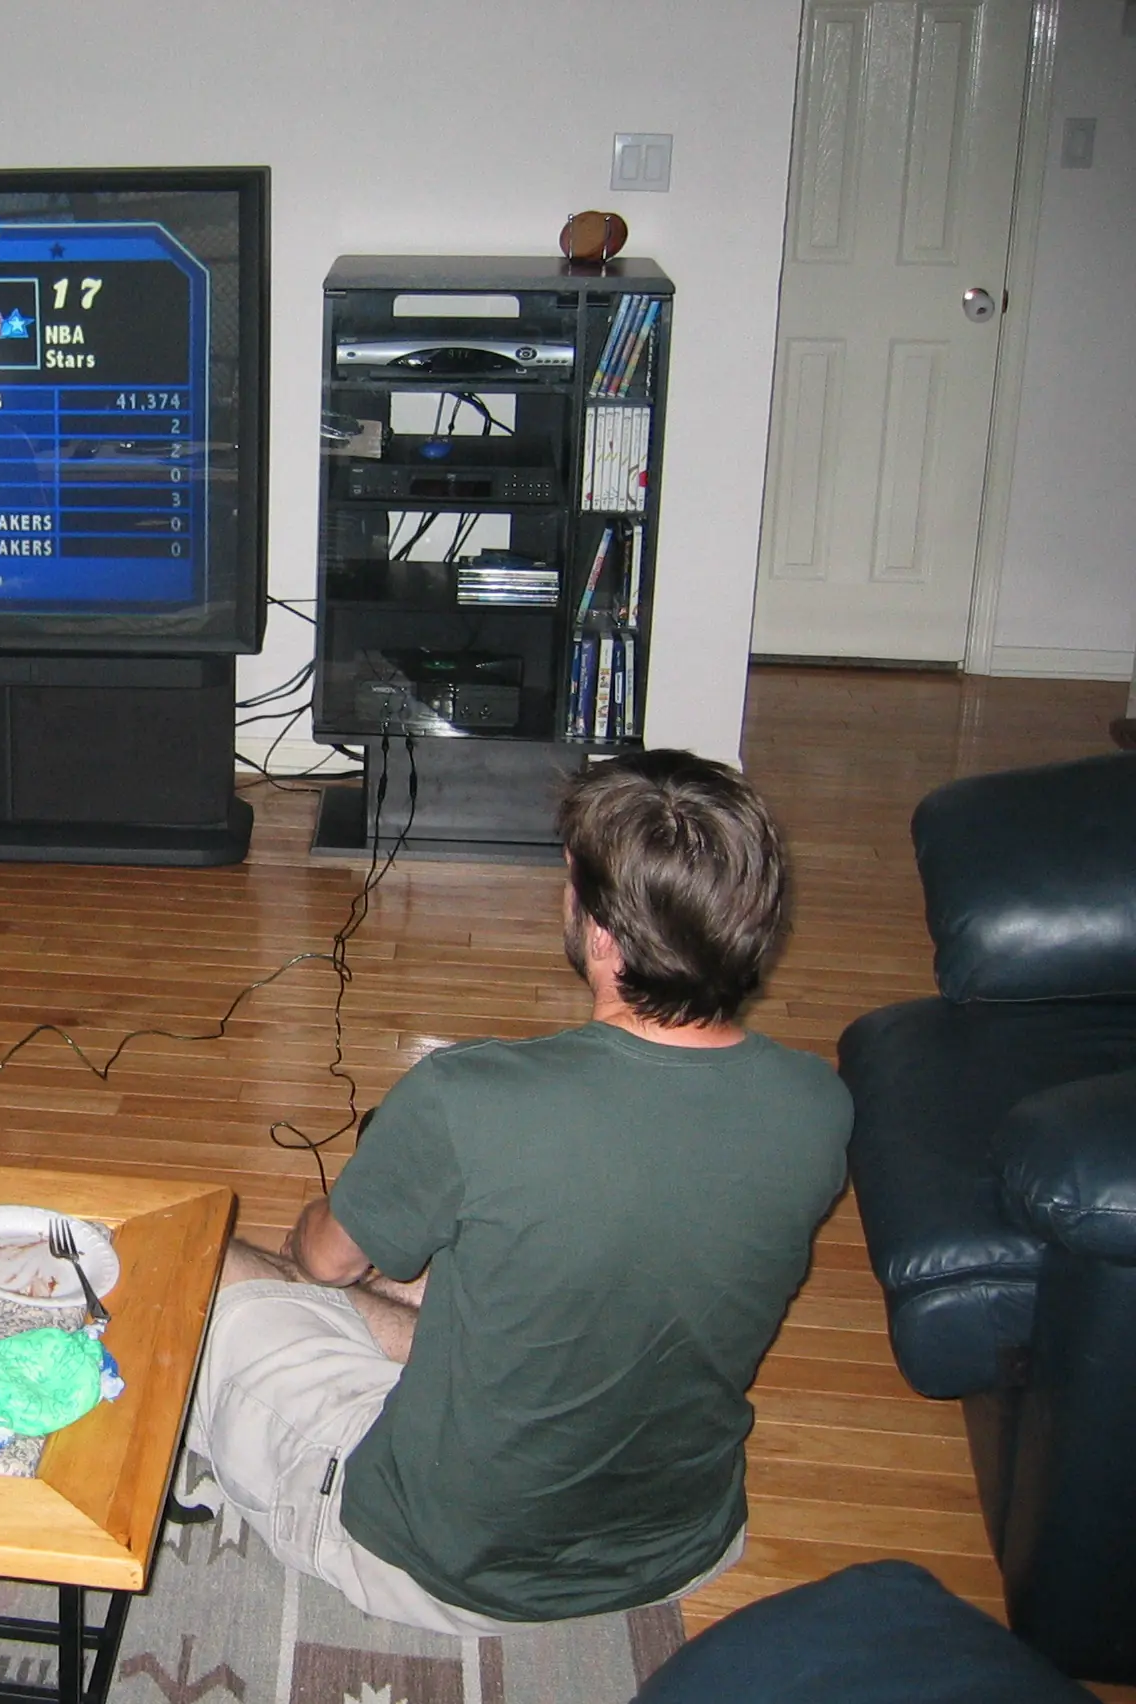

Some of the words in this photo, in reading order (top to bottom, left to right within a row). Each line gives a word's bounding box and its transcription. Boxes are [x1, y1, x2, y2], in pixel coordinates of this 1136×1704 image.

[53, 277, 102, 310] 17
[45, 325, 84, 344] NBA
[45, 349, 95, 368] Stars
[171, 418, 180, 434] 2
[171, 468, 181, 482] 0
[172, 492, 181, 507] 3
[171, 517, 181, 531] 0
[171, 542, 181, 557] 0
